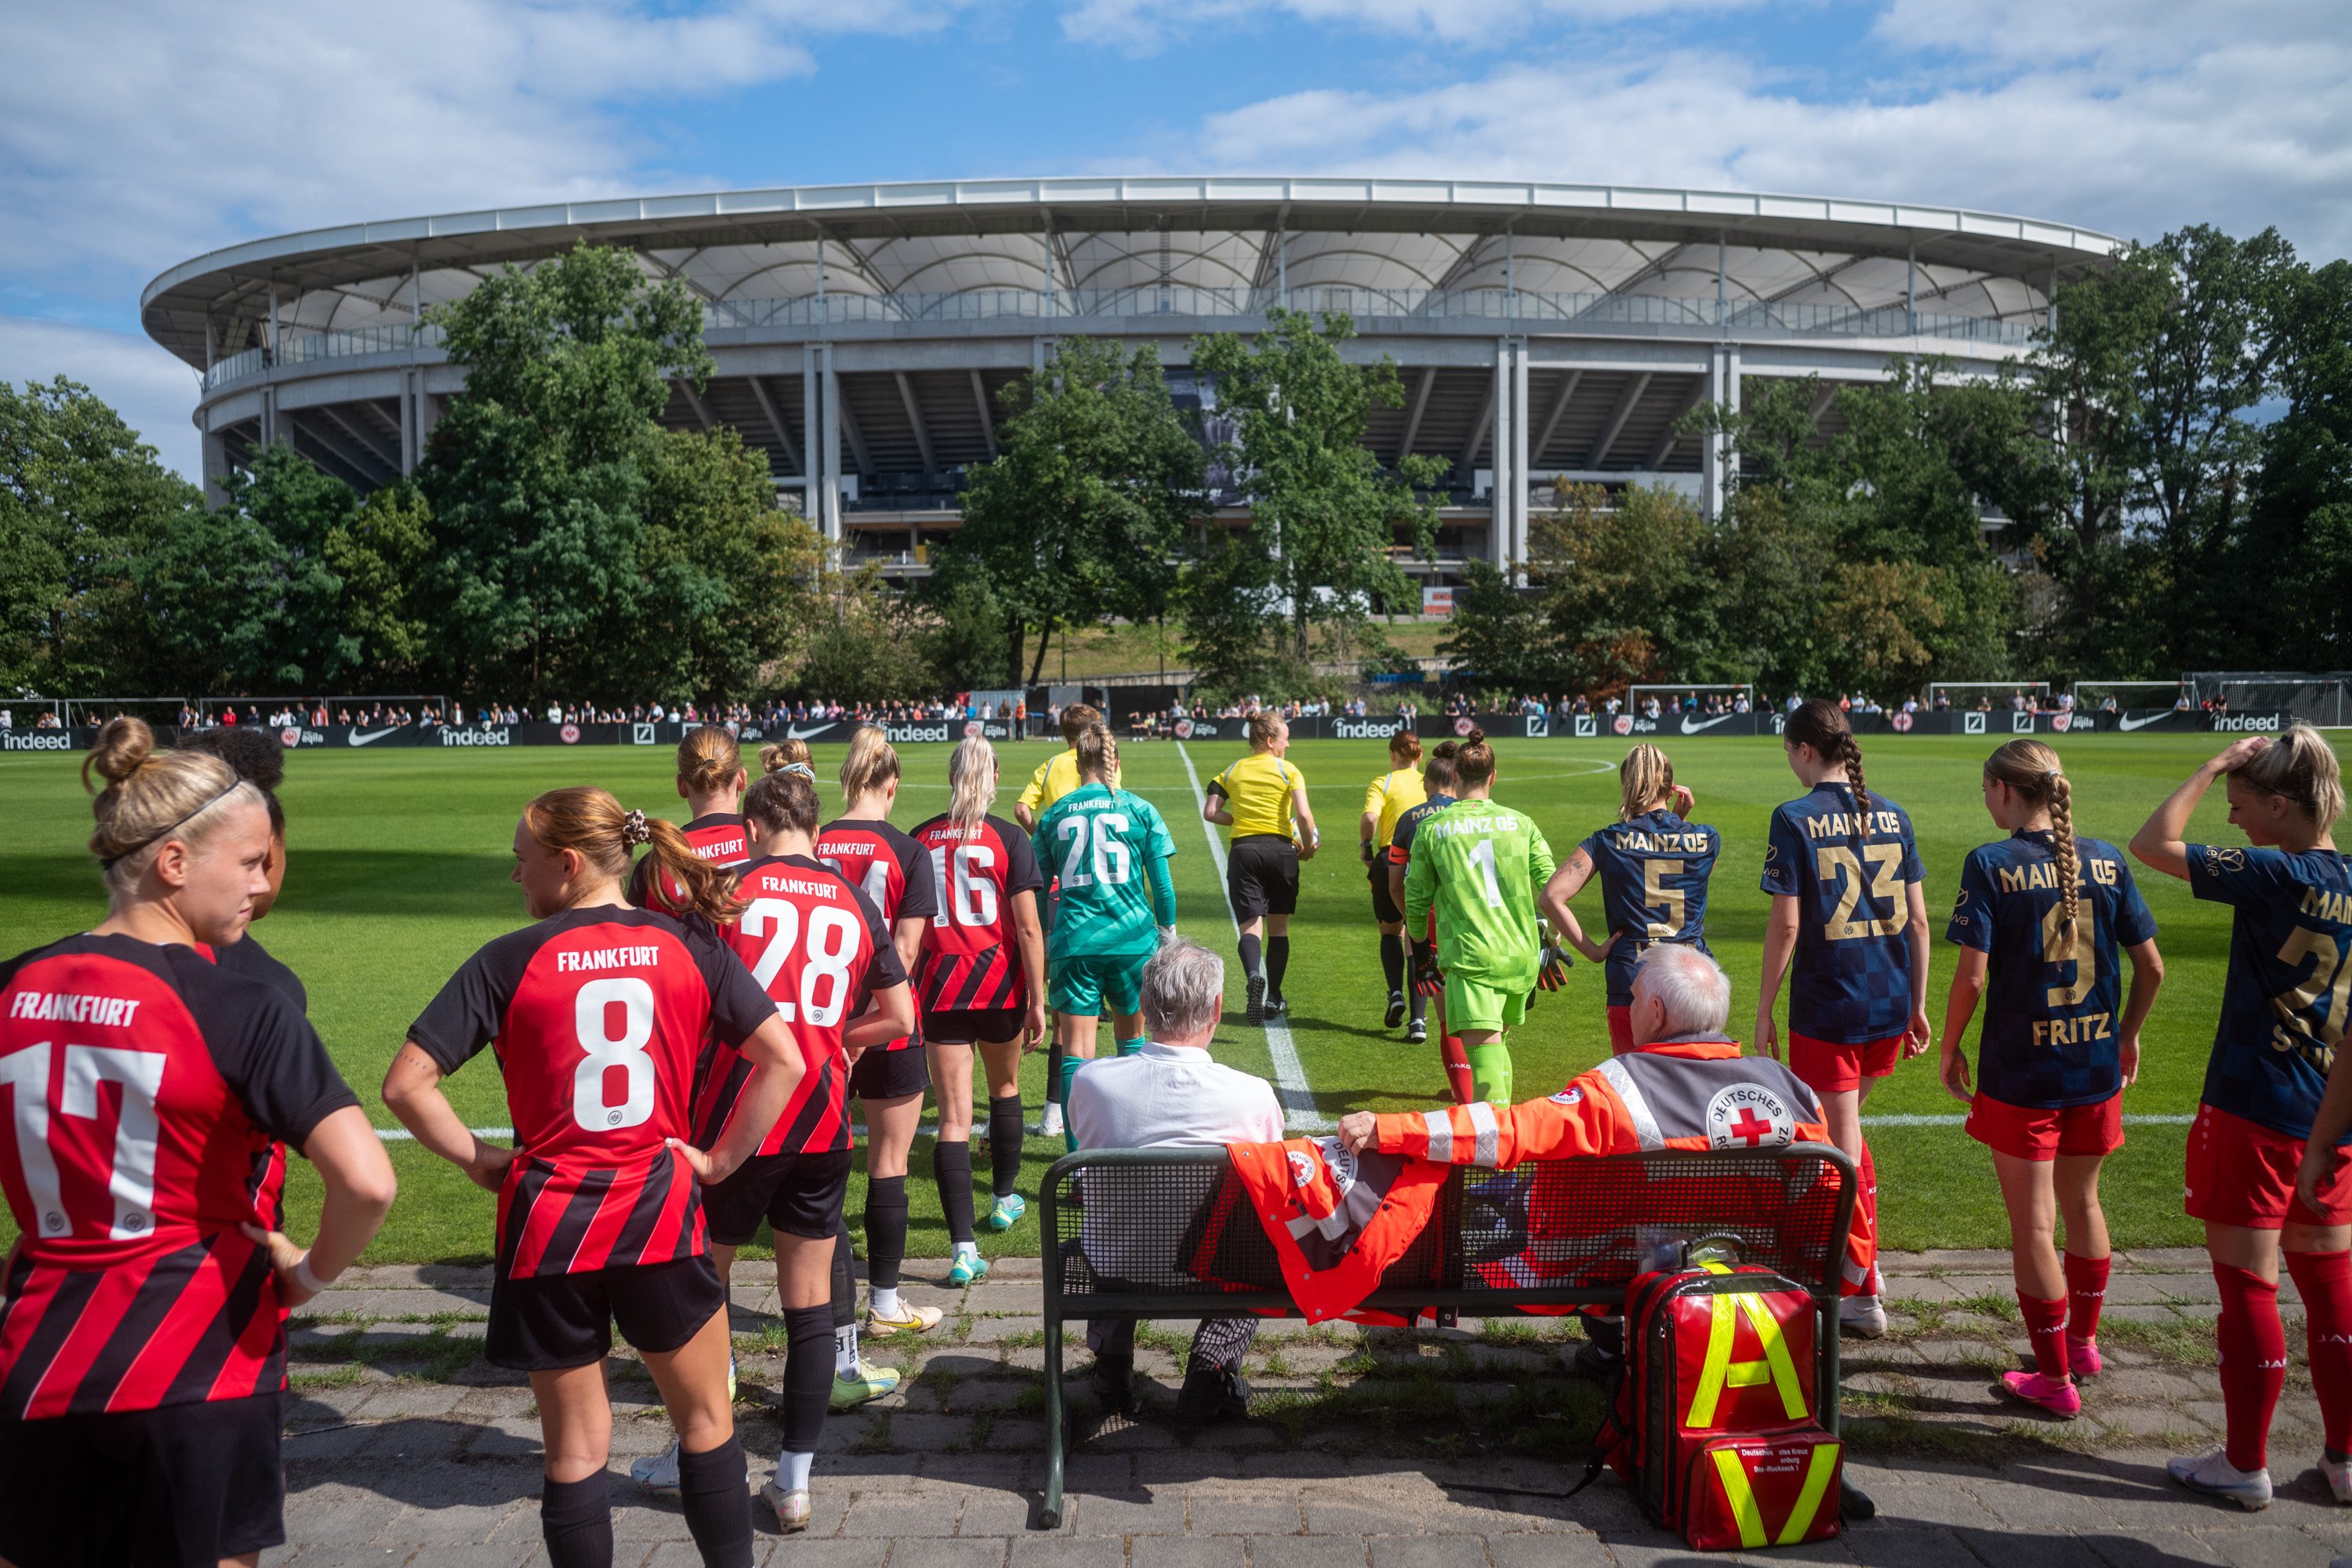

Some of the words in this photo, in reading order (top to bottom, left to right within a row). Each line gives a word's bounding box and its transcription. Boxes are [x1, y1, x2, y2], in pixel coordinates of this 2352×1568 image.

[882, 723, 949, 742] indeed
[1337, 720, 1403, 738] indeed
[2215, 713, 2279, 731] indeed
[4, 731, 71, 750] indeed
[442, 727, 510, 746] indeed
[1068, 800, 1115, 812] FRANKFURT
[930, 829, 983, 841] FRANKFRT
[1436, 817, 1494, 839] MAINZ
[1495, 816, 1519, 831] 05
[1877, 811, 1900, 834] 05
[691, 839, 744, 859] ANKFURT
[817, 843, 877, 855] FRANKFURT
[1058, 813, 1130, 889] 26
[1615, 831, 1682, 852] MAINZ
[1683, 833, 1708, 853] 05
[1468, 839, 1502, 908] 1
[1763, 867, 1780, 877] wa
[2090, 859, 2117, 885] 05
[762, 876, 838, 901] FRANKFURT
[930, 845, 998, 928] 16
[1644, 858, 1685, 938] 5
[1817, 843, 1909, 941] 23
[1951, 913, 1969, 926] wa
[557, 946, 659, 972] FRANKFURT
[740, 898, 862, 1029] 28
[2042, 898, 2096, 1007] 9
[9, 993, 141, 1028] FRANKFURT
[2032, 1012, 2111, 1047] FRITZ
[573, 978, 655, 1132] 8
[1713, 1090, 1782, 1123] DEUTSCHES
[0, 1041, 167, 1240] 17
